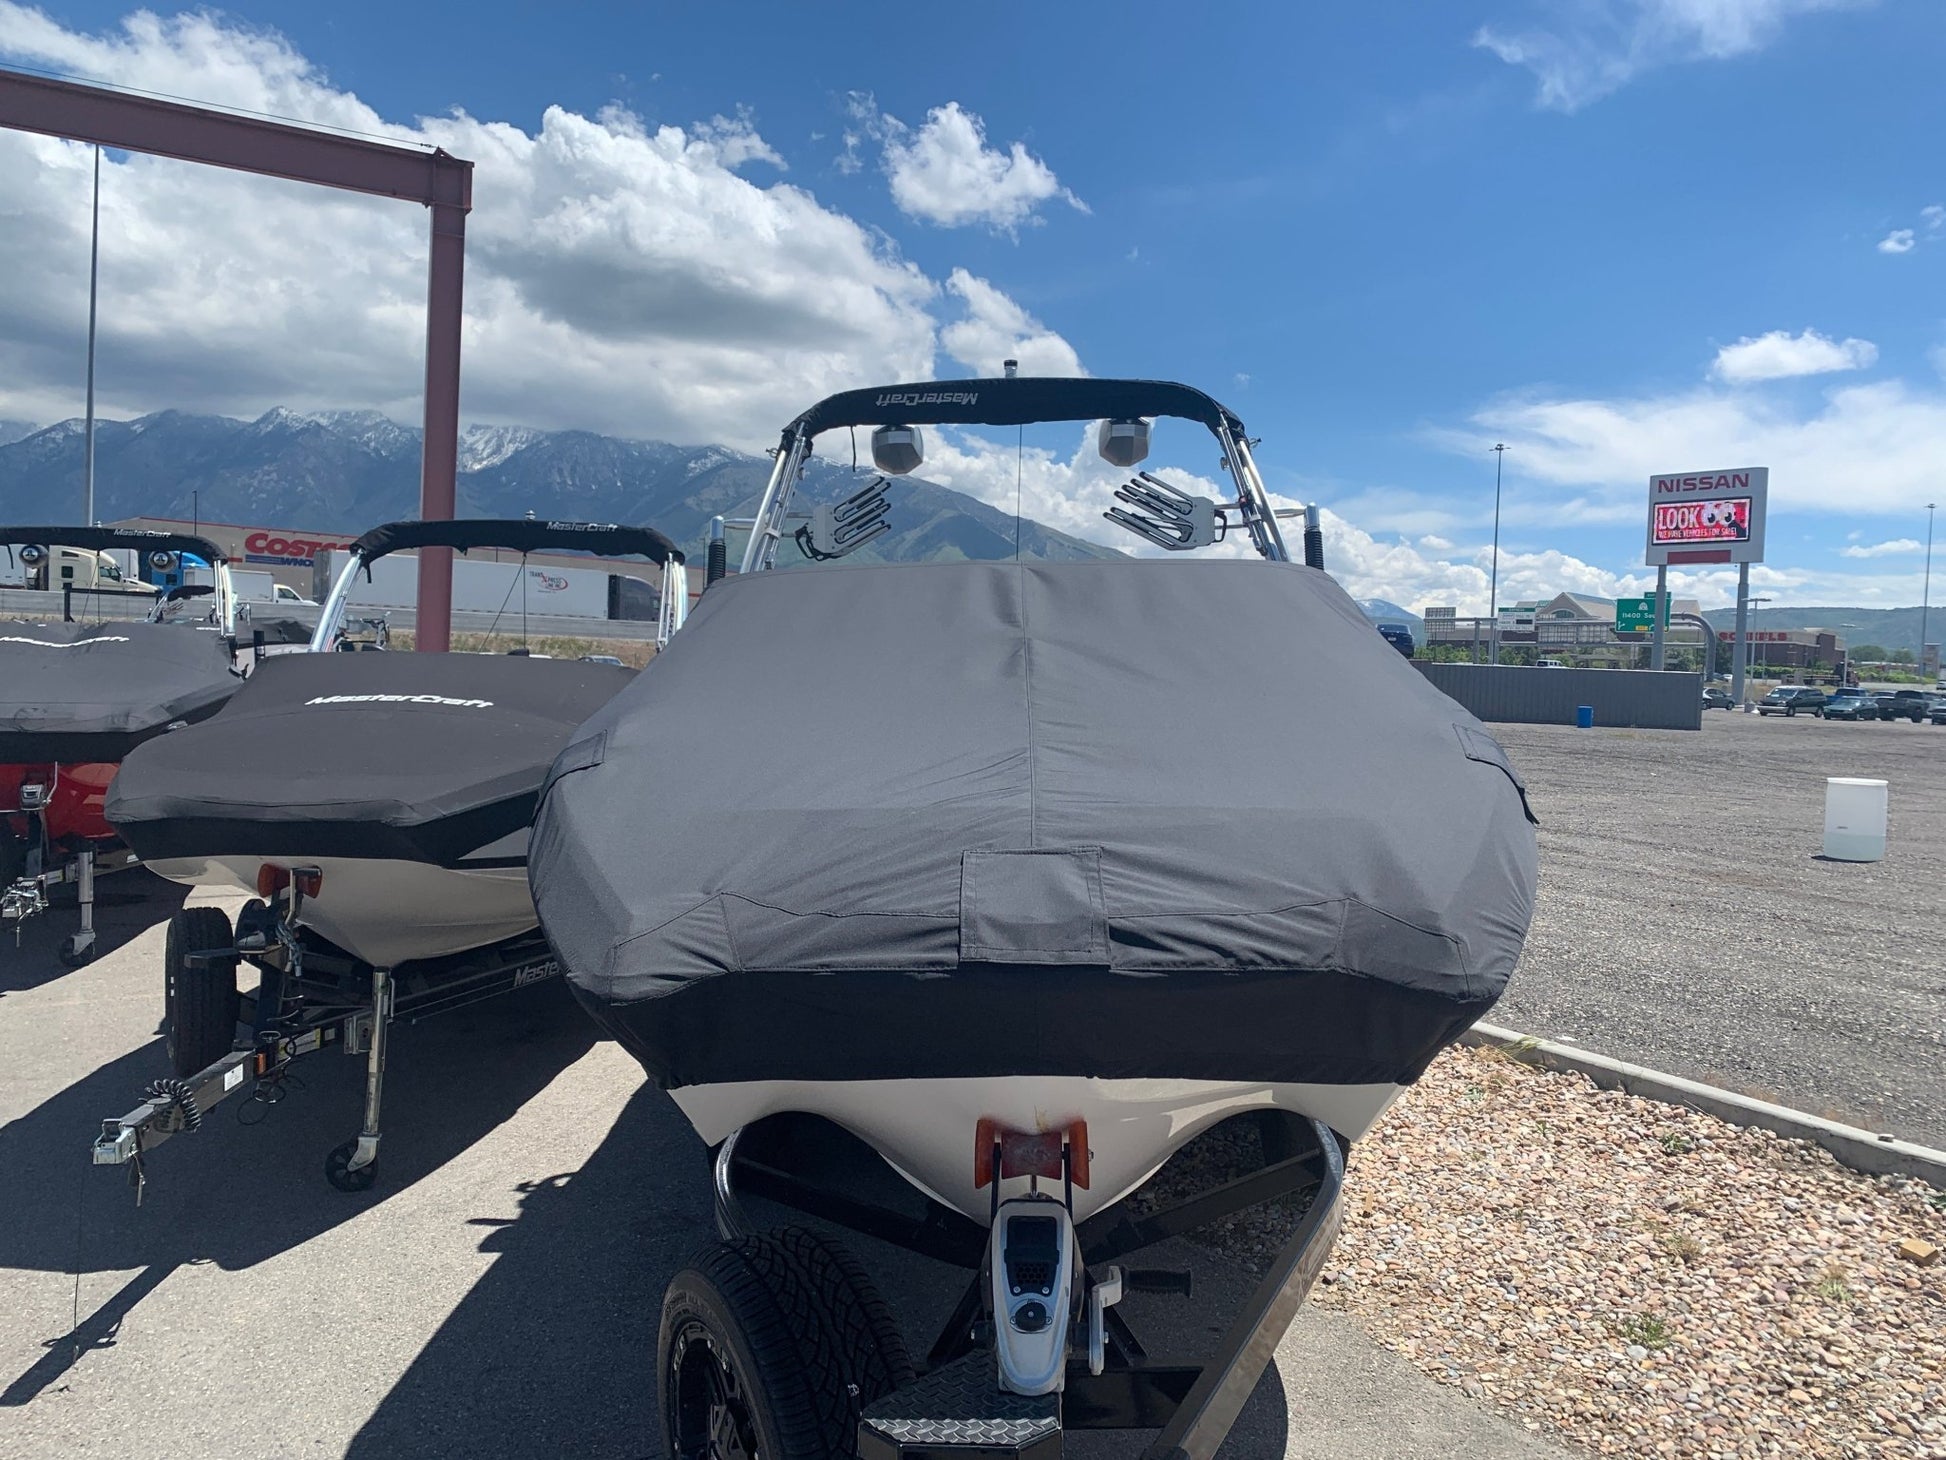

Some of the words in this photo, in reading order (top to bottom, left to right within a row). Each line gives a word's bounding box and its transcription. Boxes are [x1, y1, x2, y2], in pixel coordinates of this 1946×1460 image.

[875, 392, 979, 407] MasterCraft
[1658, 473, 1749, 493] NISSAN
[1658, 507, 1700, 530] LOOK
[113, 528, 172, 538] MasterCraft
[546, 521, 618, 533] MasterCraft
[304, 694, 494, 709] MasterCraft
[513, 961, 563, 987] Maste
